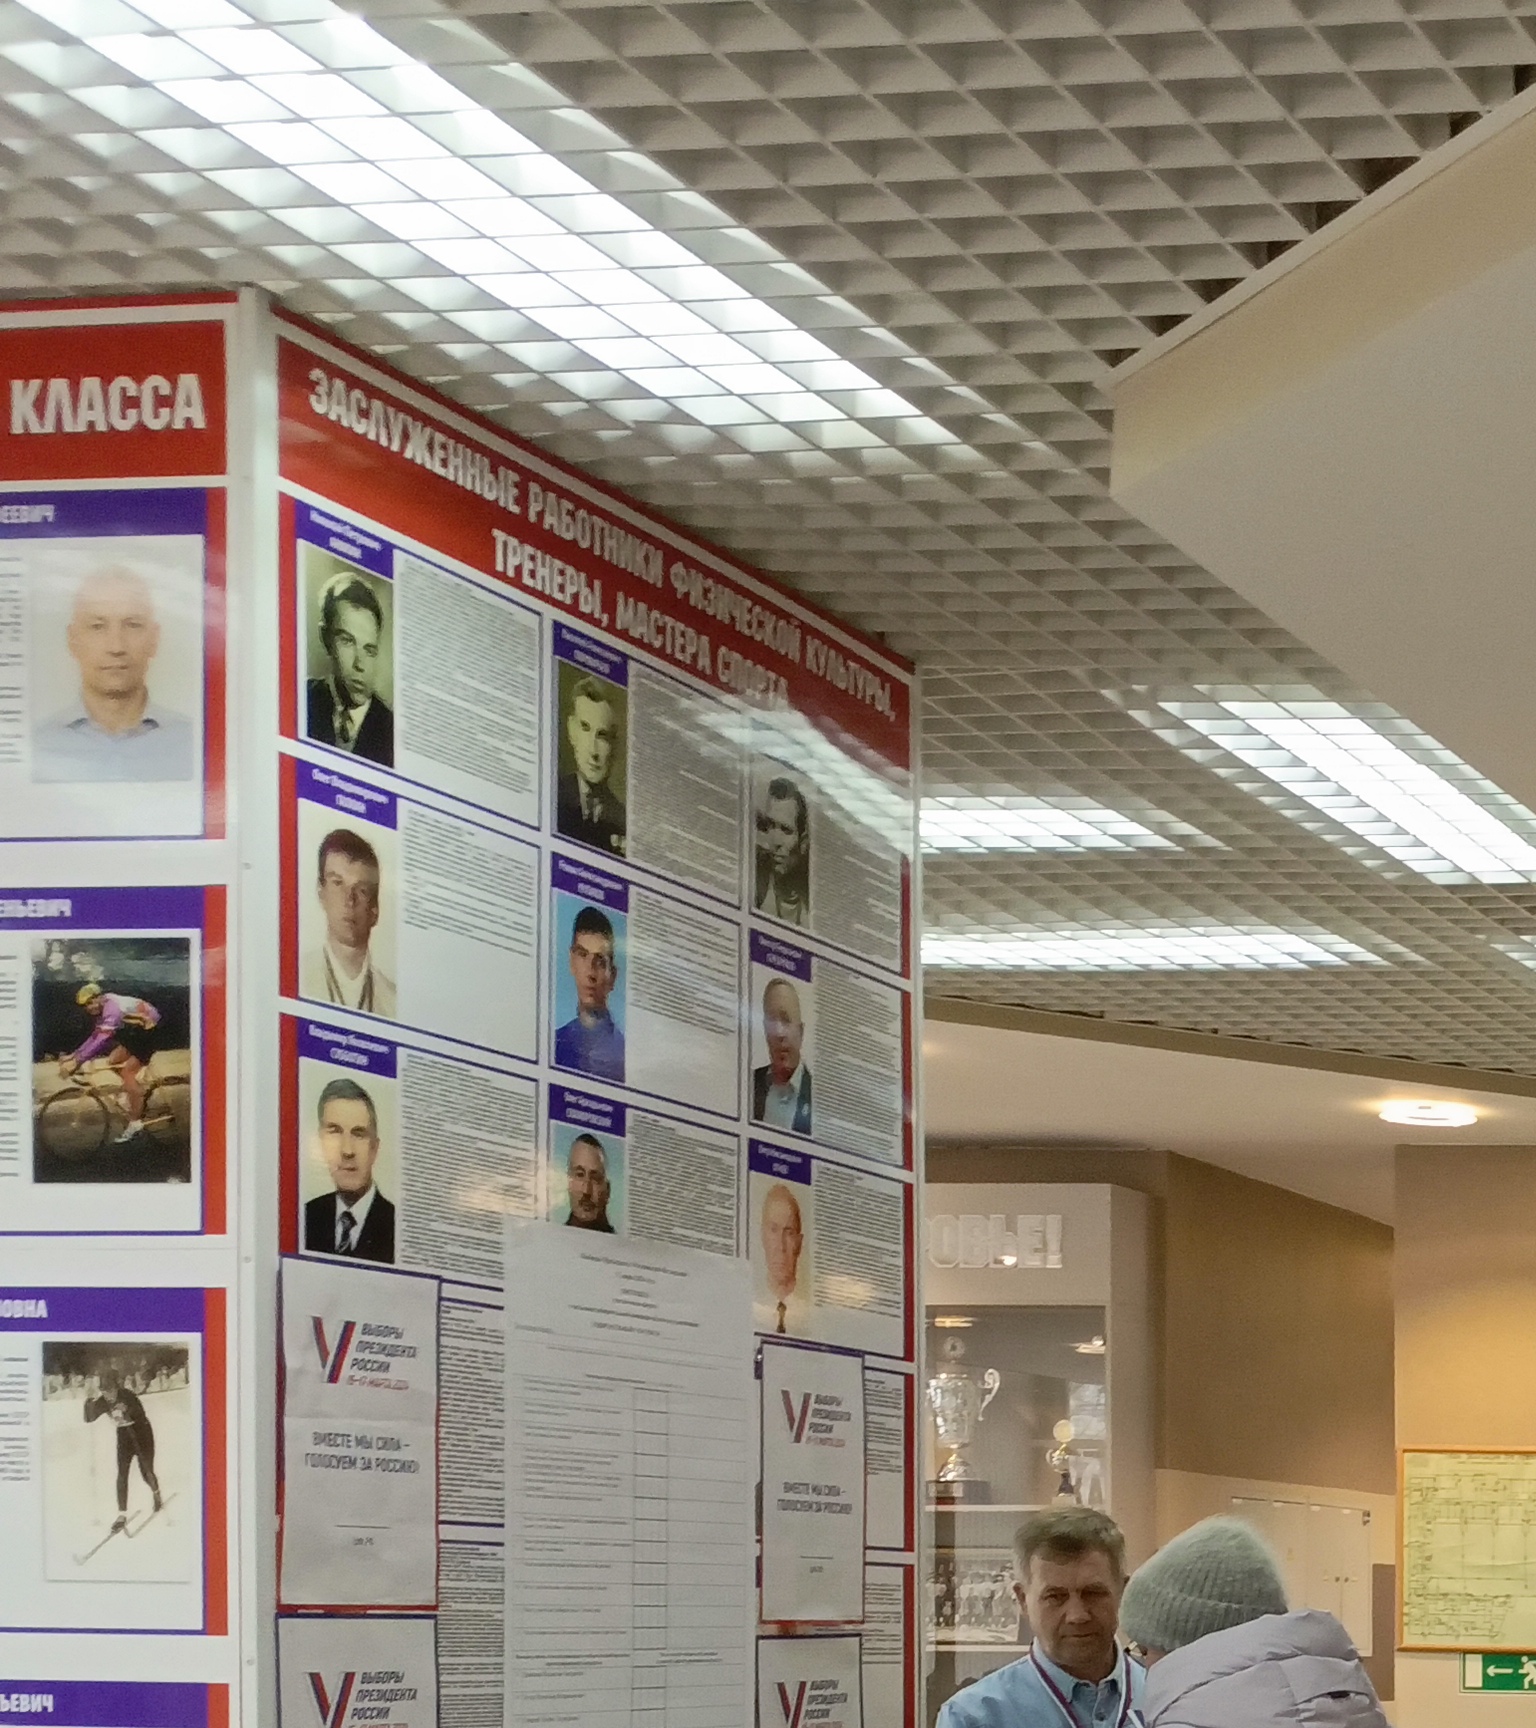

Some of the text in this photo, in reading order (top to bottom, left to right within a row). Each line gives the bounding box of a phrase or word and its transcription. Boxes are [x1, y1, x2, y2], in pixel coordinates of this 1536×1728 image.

[10, 373, 206, 434] КЛАССА
[309, 367, 521, 515] ЗАСЛУЖЕННЫЕ
[527, 480, 663, 587] РАБОТНИКИ
[670, 561, 802, 664] ФИЗИЧЕСКОЙ
[490, 528, 609, 628] ТРЕНЕРЫ,
[615, 591, 712, 676] МАСТЕРА
[925, 1213, 1063, 1269] ОВЬЕ!
[361, 1323, 404, 1339] ВЫБОРЫ
[350, 1358, 391, 1374] РОССИИ
[361, 1671, 405, 1684] ВЫБОРЫ
[355, 1688, 418, 1703] ПРЕЗИДЕНТА
[350, 1706, 391, 1720] РОССИИ
